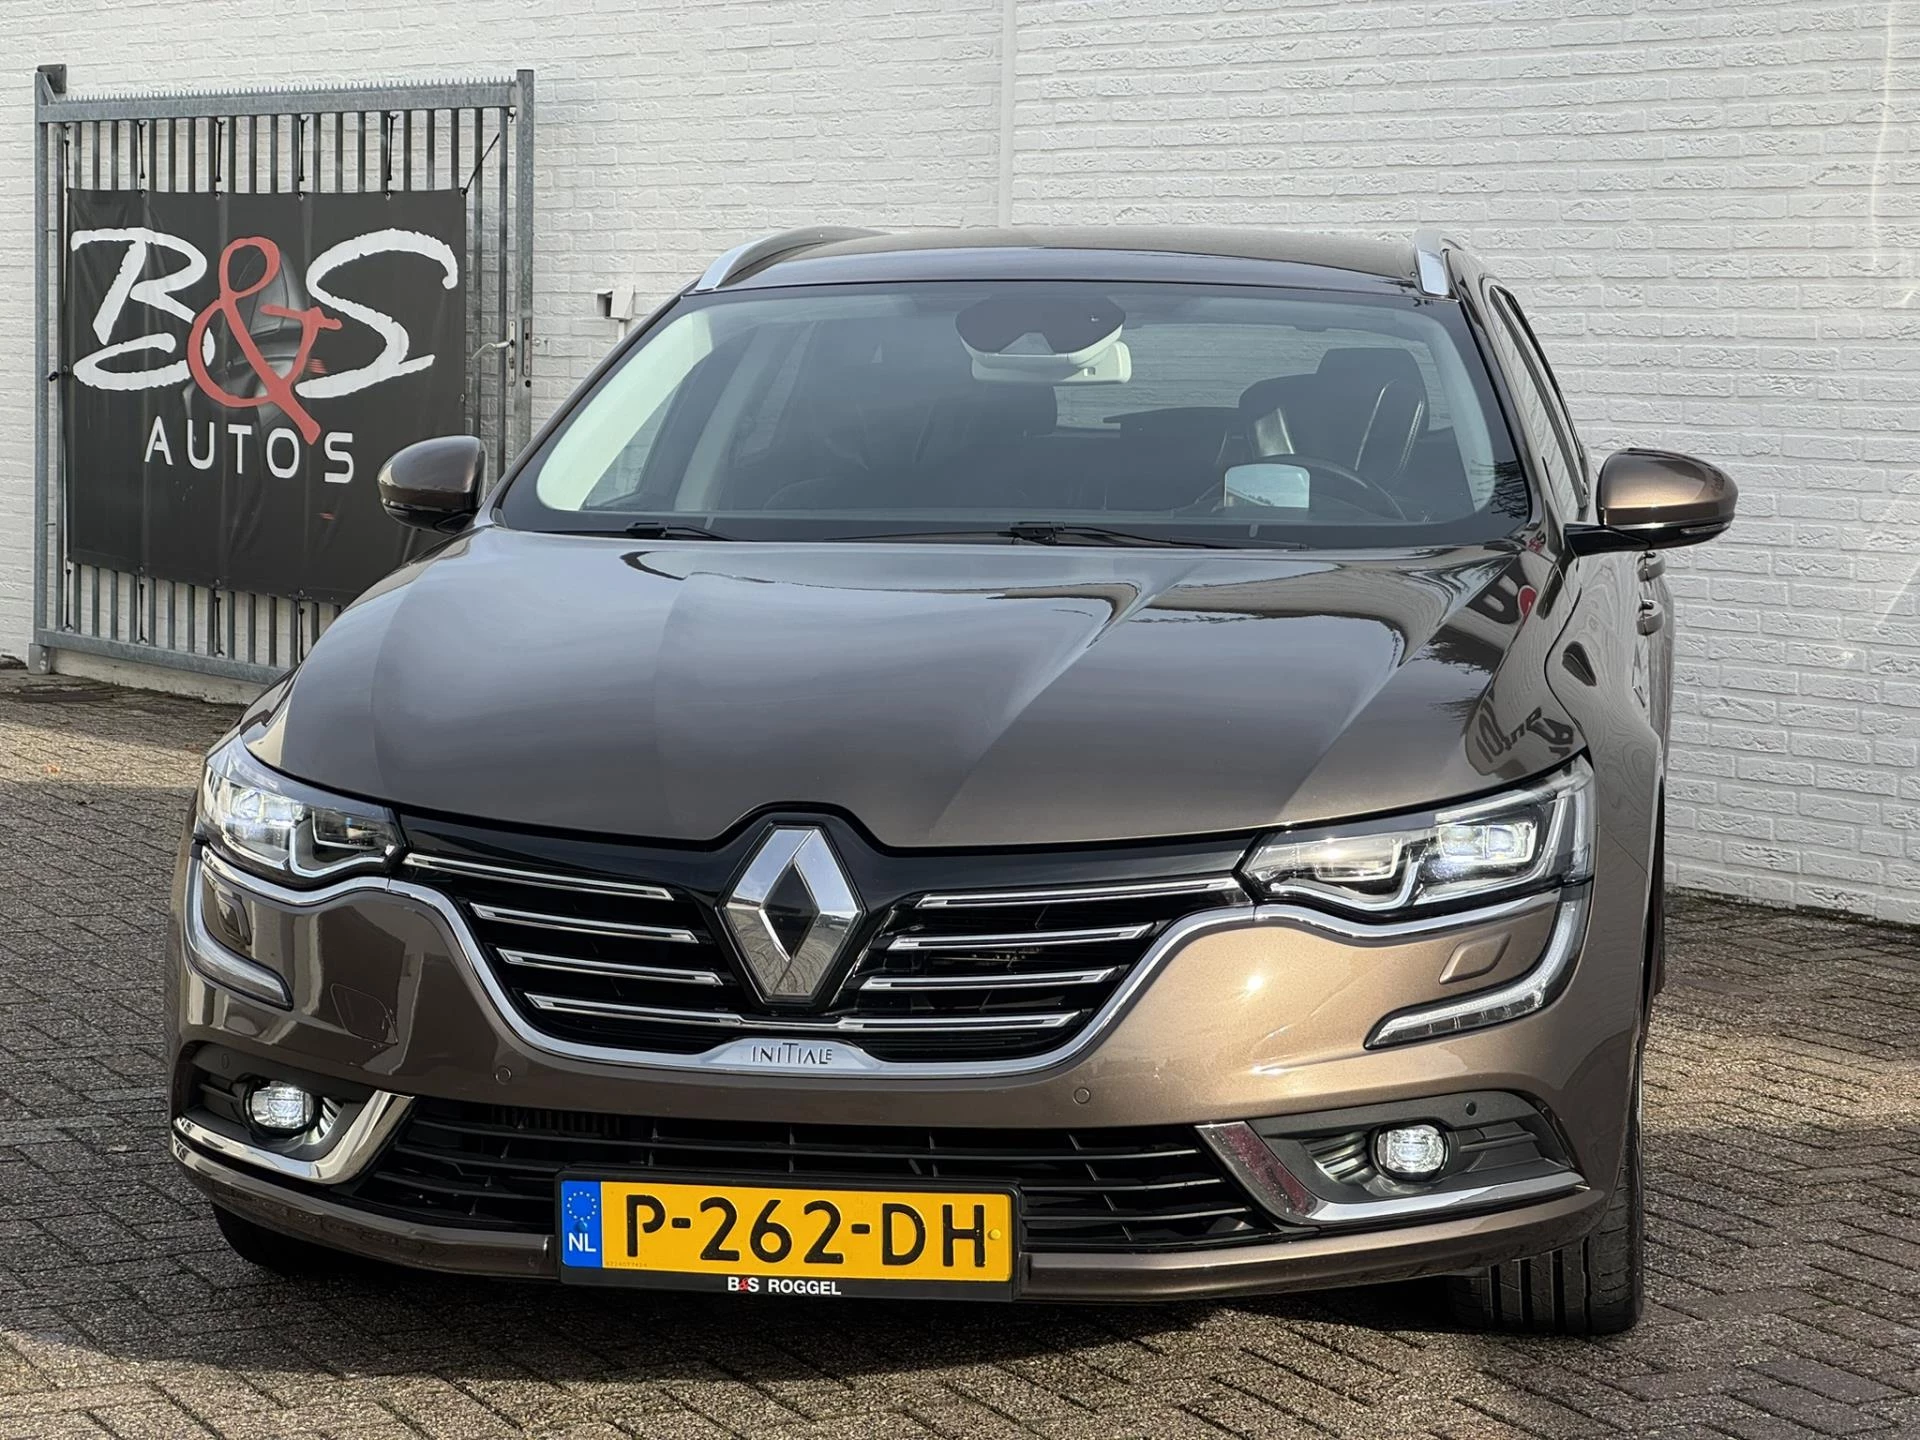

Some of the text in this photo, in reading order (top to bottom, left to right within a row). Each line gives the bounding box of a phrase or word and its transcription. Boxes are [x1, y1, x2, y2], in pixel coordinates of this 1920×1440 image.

[70, 226, 458, 445] B&S
[144, 415, 355, 485] AUTOS
[752, 1042, 832, 1065] INITIALE
[568, 1232, 597, 1253] NL
[626, 1194, 986, 1268] P-262-DH
[727, 1276, 842, 1296] B&S ROGGEL
